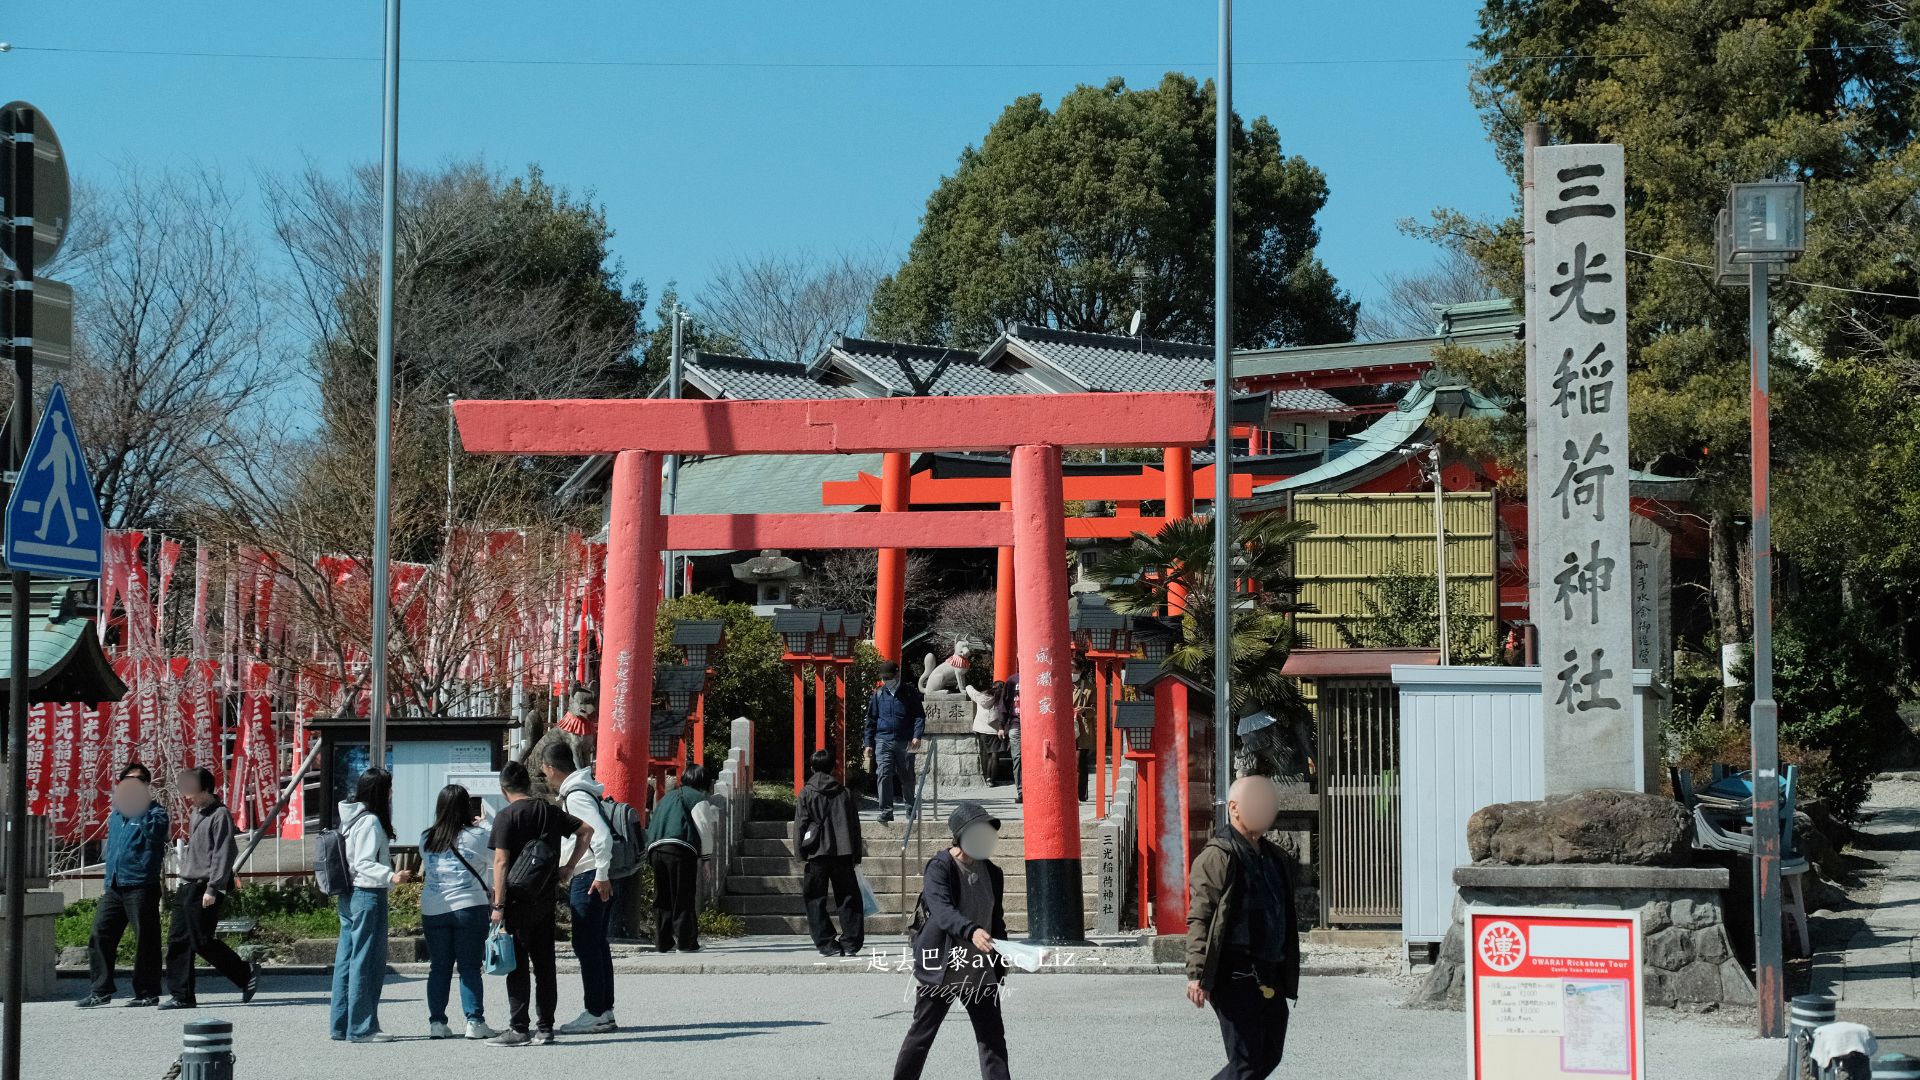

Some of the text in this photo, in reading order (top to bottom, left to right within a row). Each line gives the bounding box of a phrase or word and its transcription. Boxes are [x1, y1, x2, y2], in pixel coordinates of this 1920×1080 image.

[1546, 163, 1621, 713] 三光稲荷神社
[1103, 835, 1113, 914] 三光稲荷神社
[1567, 959, 1605, 968] Rickshaw
[1608, 960, 1628, 968] Tour
